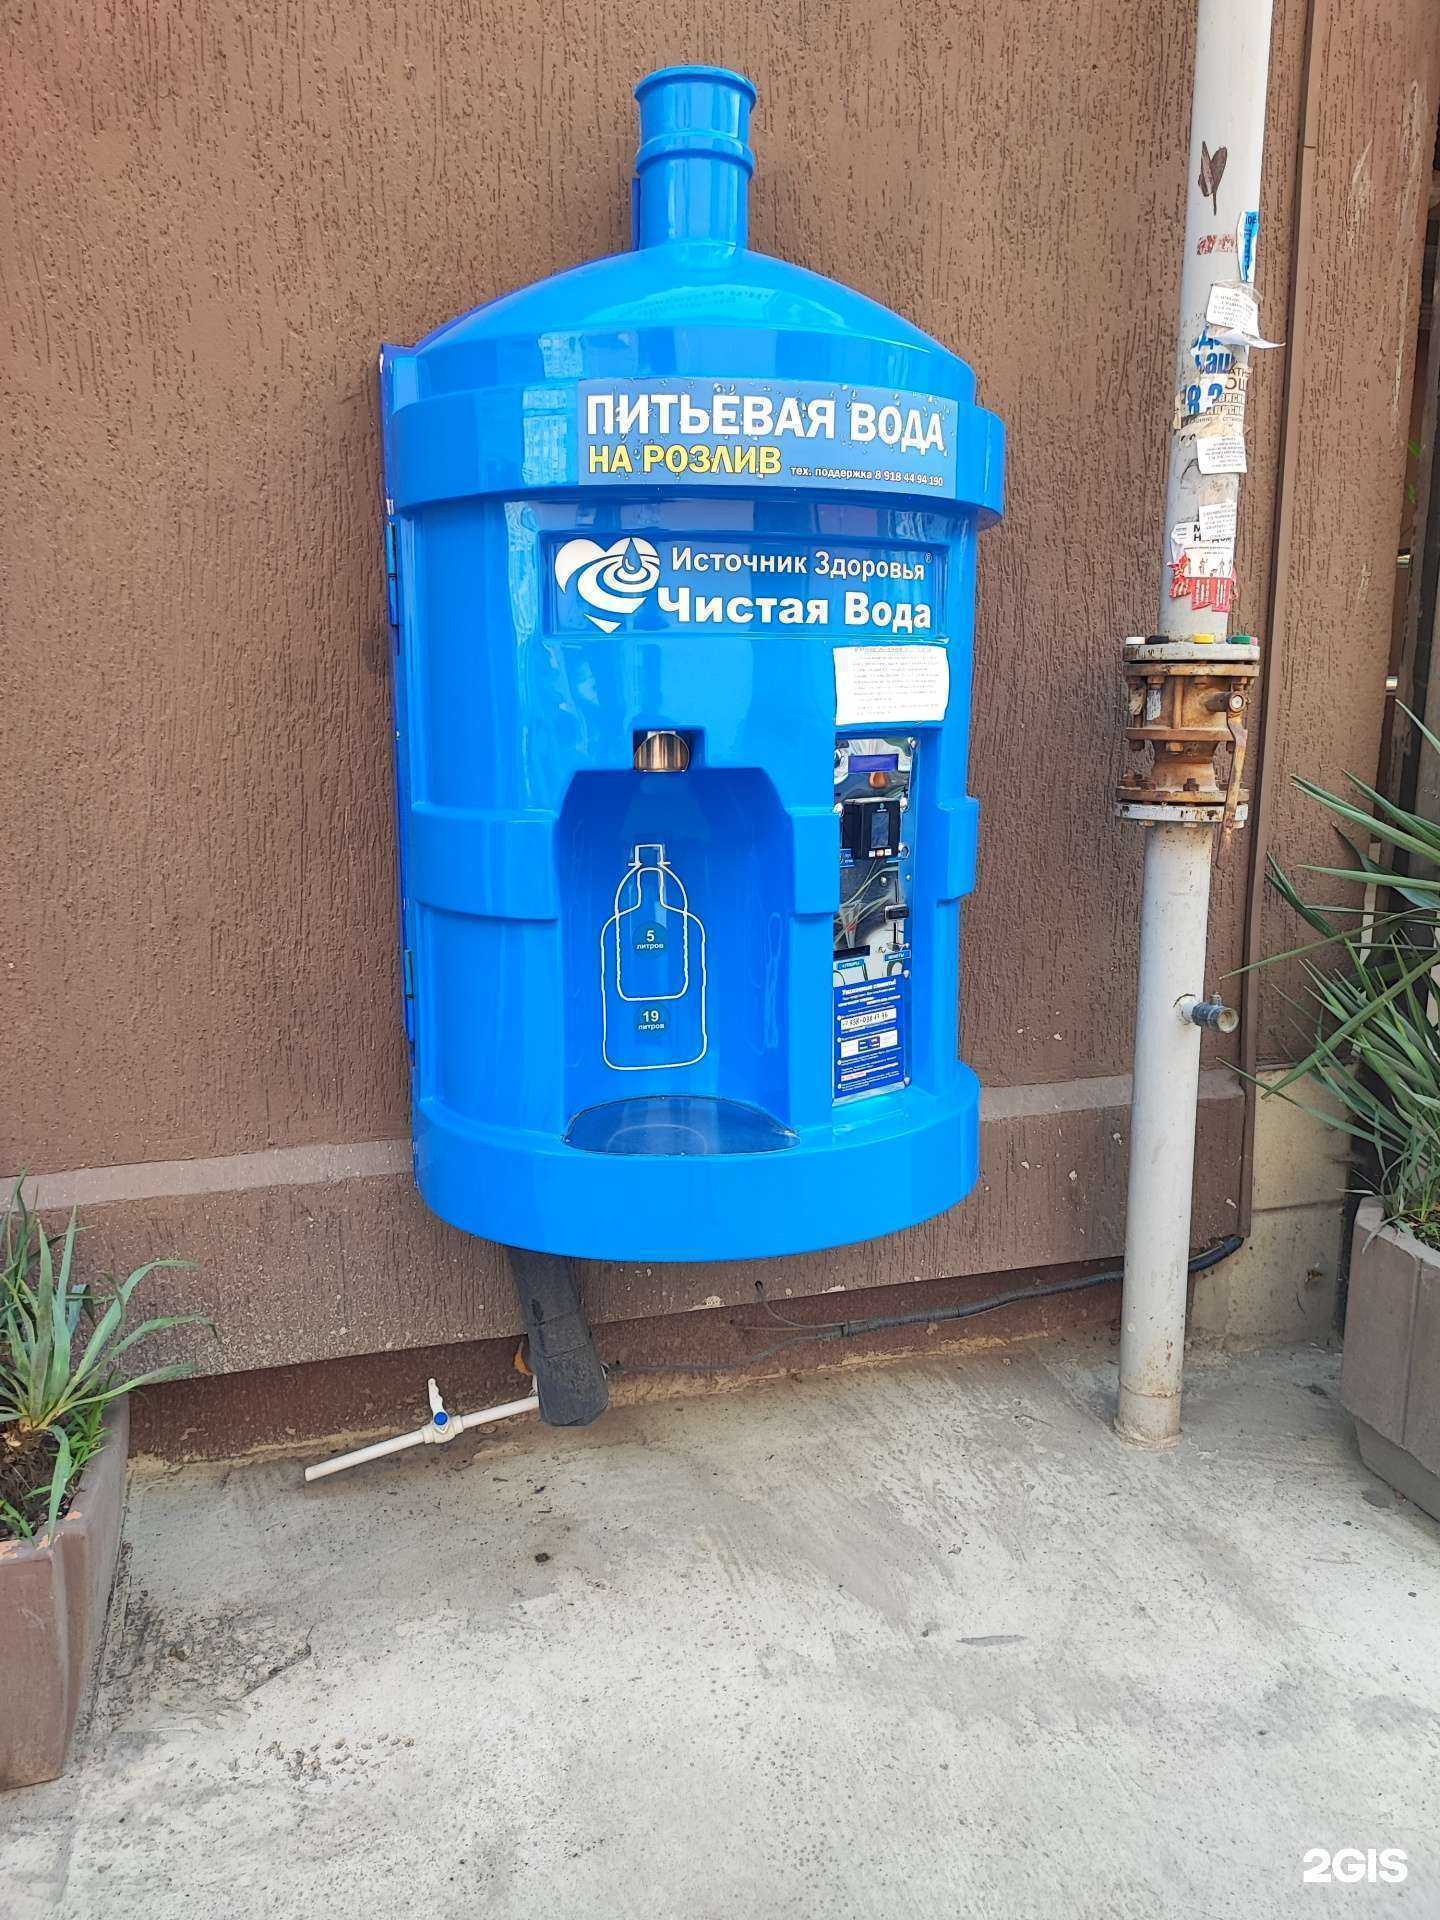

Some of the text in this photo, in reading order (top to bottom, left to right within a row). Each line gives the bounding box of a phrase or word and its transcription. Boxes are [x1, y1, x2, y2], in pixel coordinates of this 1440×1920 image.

[586, 394, 945, 455] ПИТЬЕВАЯ ВОДА
[588, 445, 782, 475] НА РОЗЛИВ
[790, 466, 944, 487] тех. поддержка 8 918 44 94 190
[672, 547, 925, 582] Источник Здоровья
[657, 587, 932, 634] Чистая Вода
[646, 929, 655, 942] 5
[638, 1023, 665, 1031] литров
[642, 1010, 660, 1023] 19
